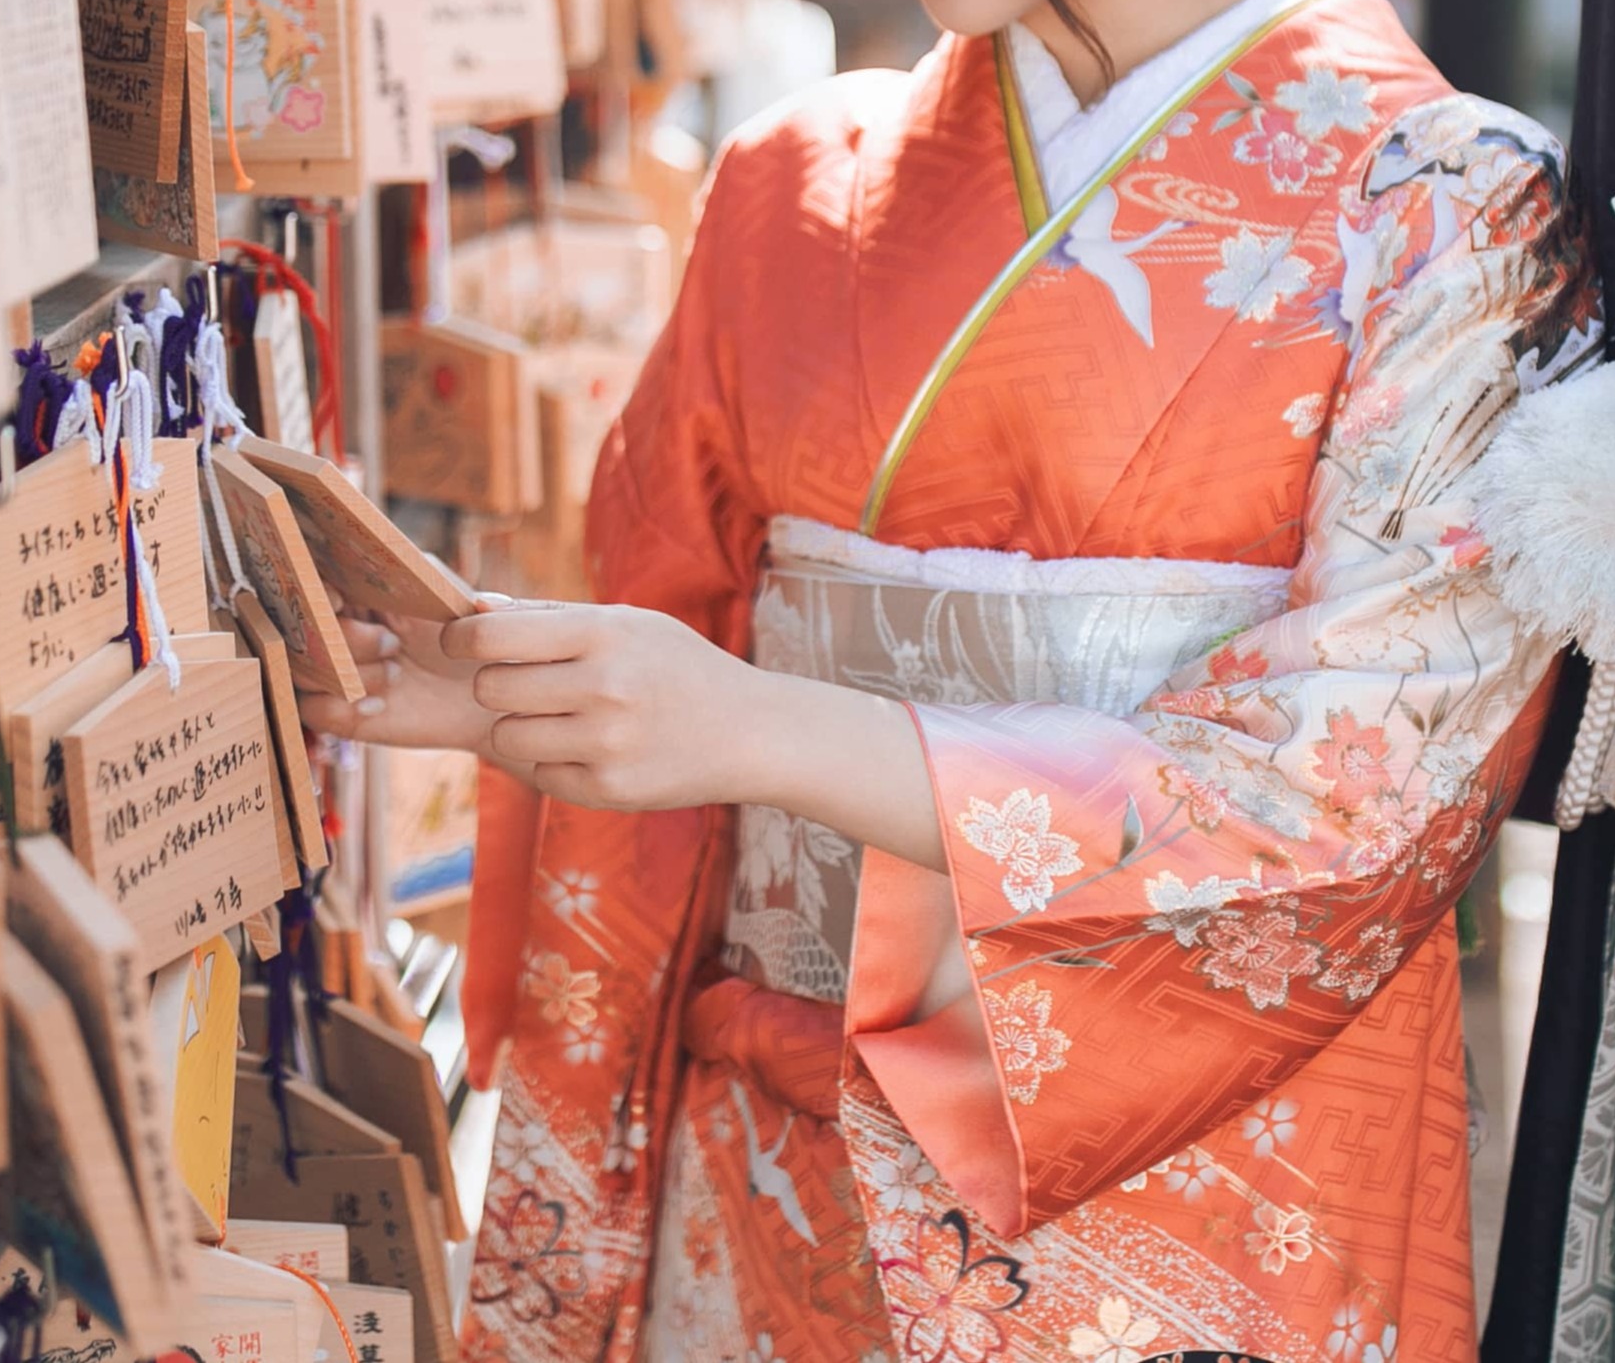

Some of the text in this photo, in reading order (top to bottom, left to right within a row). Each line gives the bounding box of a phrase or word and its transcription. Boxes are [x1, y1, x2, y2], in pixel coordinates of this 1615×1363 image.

[22, 539, 161, 622] 健康に過ごす
